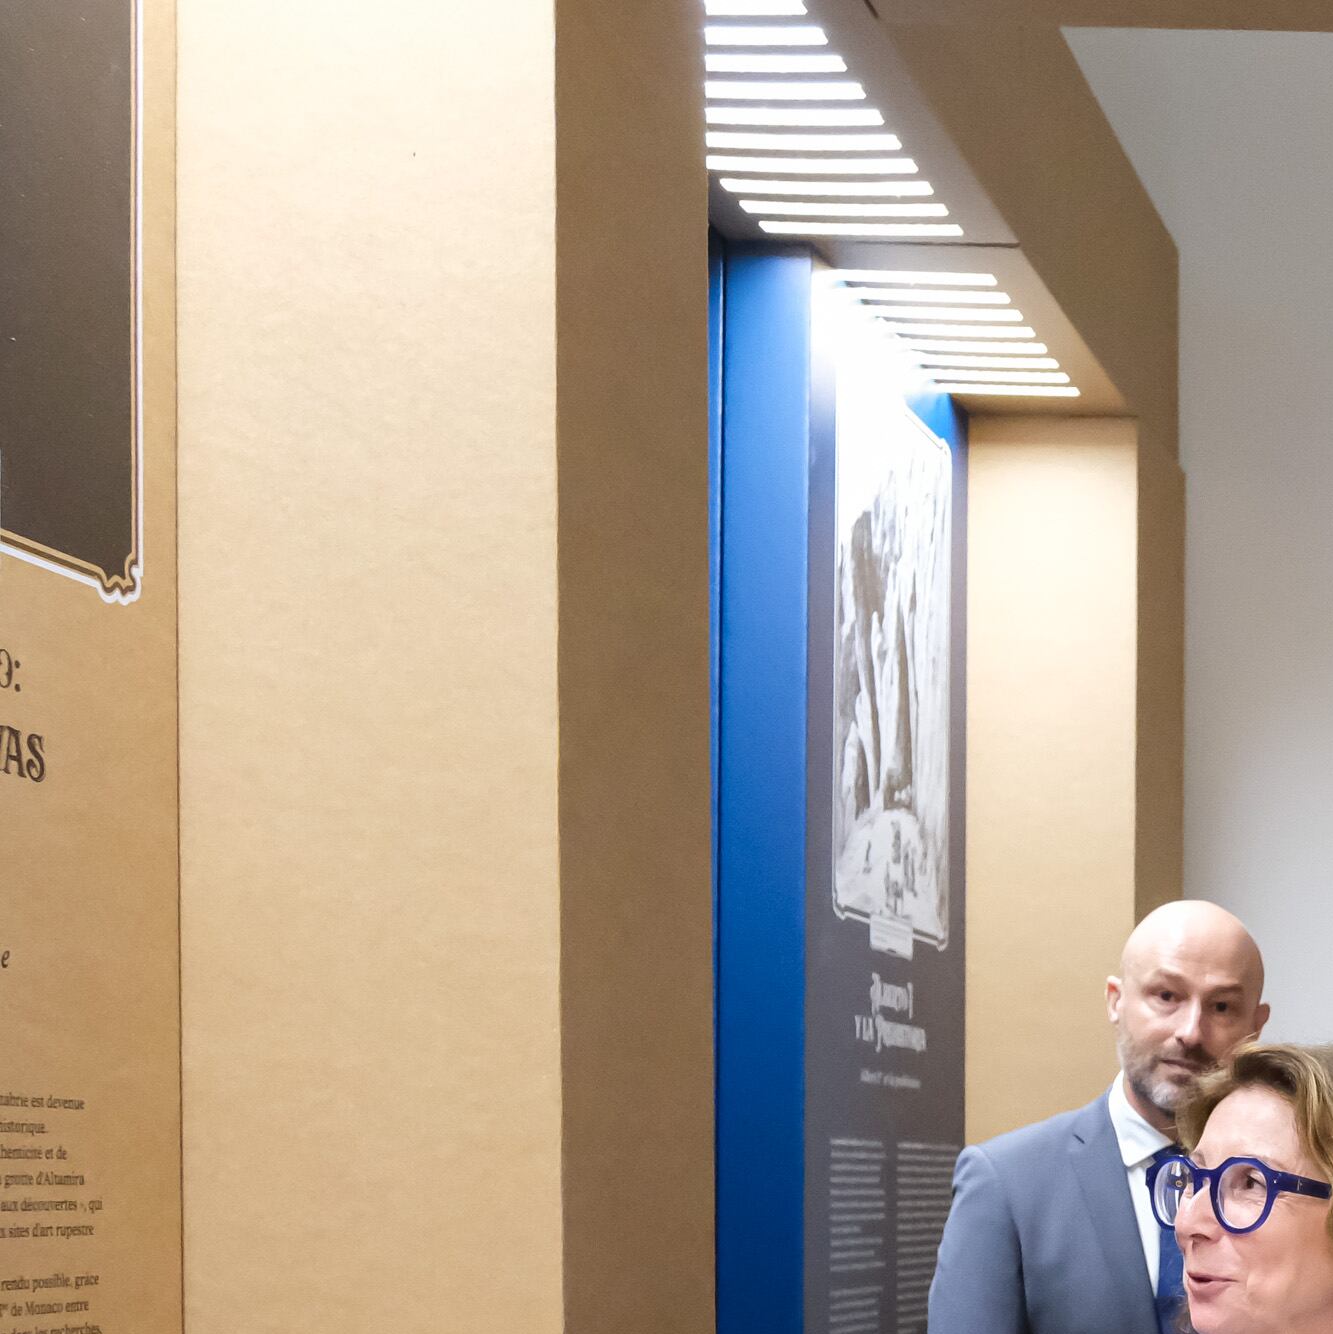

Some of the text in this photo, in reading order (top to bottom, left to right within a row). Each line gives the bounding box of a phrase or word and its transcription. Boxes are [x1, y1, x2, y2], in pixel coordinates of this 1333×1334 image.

[47, 1094, 84, 1110] devenue
[56, 1146, 68, 1160] de
[56, 1224, 95, 1239] rupestre
[10, 1303, 23, 1316] de
[25, 1301, 63, 1316] Monaco
[65, 1300, 90, 1312] entre
